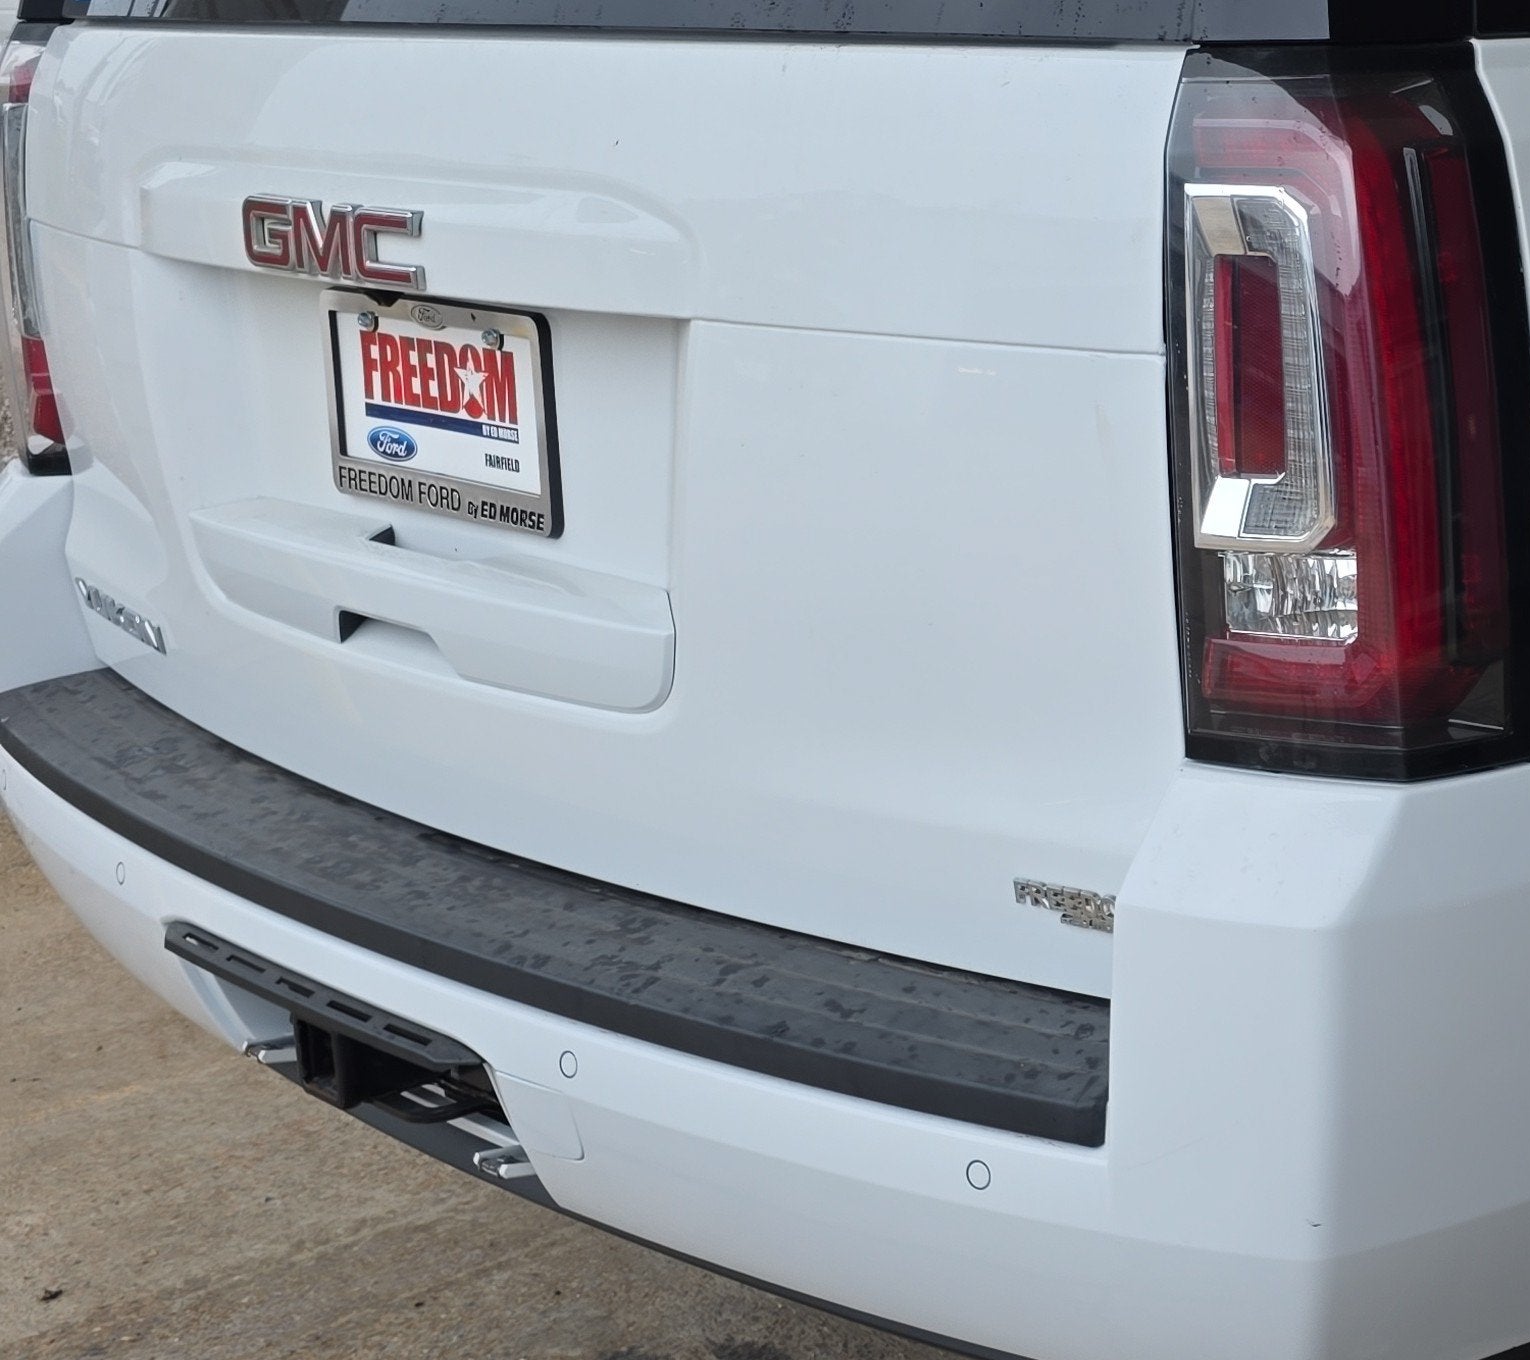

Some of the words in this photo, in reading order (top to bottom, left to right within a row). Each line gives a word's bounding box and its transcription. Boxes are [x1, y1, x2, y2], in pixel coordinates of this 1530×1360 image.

[242, 193, 427, 291] GMC
[359, 330, 518, 426] FREEDOM
[376, 429, 408, 458] Ford
[484, 453, 520, 474] FAIRFIELD
[338, 465, 414, 503] FREEDOM
[418, 481, 461, 512] FORD
[481, 500, 497, 520] ED
[499, 504, 545, 532] MORSE
